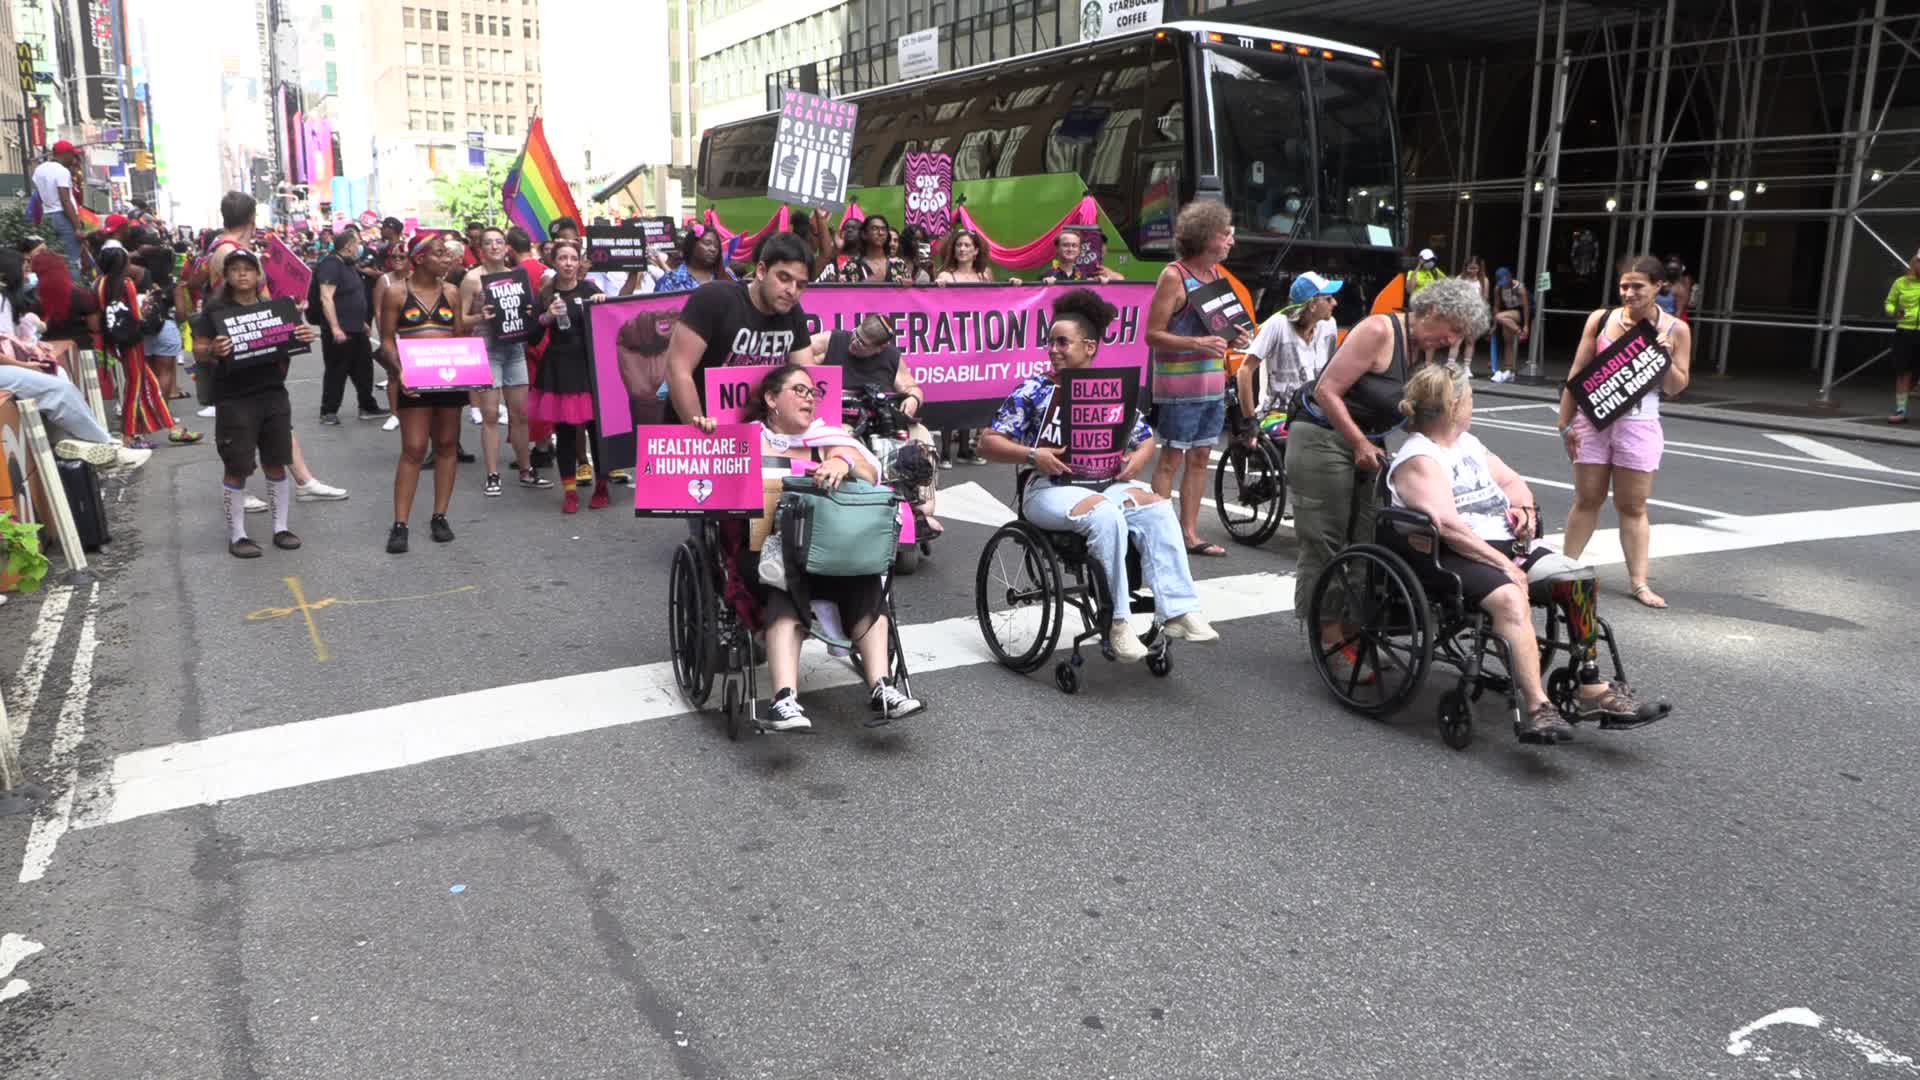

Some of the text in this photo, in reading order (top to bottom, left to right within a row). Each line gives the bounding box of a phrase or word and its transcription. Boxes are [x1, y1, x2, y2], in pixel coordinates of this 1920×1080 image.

[1108, 0, 1160, 13] STARBUC
[1116, 11, 1148, 27] COFFEE
[785, 92, 856, 116] WE MARCH
[783, 103, 853, 129] AGAINST
[780, 117, 852, 147] POLICE
[779, 133, 849, 157] OPPRESSION
[916, 175, 939, 188] GAY
[920, 187, 933, 199] IS
[908, 191, 947, 213] GOOD
[489, 282, 525, 299] THANK
[499, 295, 521, 310] GOD
[224, 317, 237, 327] WE
[505, 308, 519, 320] I'M
[227, 323, 247, 335] HAVE
[247, 321, 257, 331] TO
[502, 319, 524, 334] GAY!
[1036, 305, 1140, 350] MCH
[234, 342, 249, 352] AND
[732, 327, 794, 357] QUEER
[915, 361, 1051, 384] DISABILITY JUST
[1583, 335, 1647, 393] DISABILITY
[1588, 345, 1658, 406] RIGHTS ARE
[1073, 381, 1120, 398] BLACK
[1594, 354, 1667, 420] CIVIL RIGHTS
[720, 382, 750, 410] NO
[1073, 407, 1108, 422] DEAF
[648, 438, 750, 455] HEALTHCARE IS
[1073, 432, 1110, 448] LIVES
[644, 457, 751, 475] A HUMAN RIGHT
